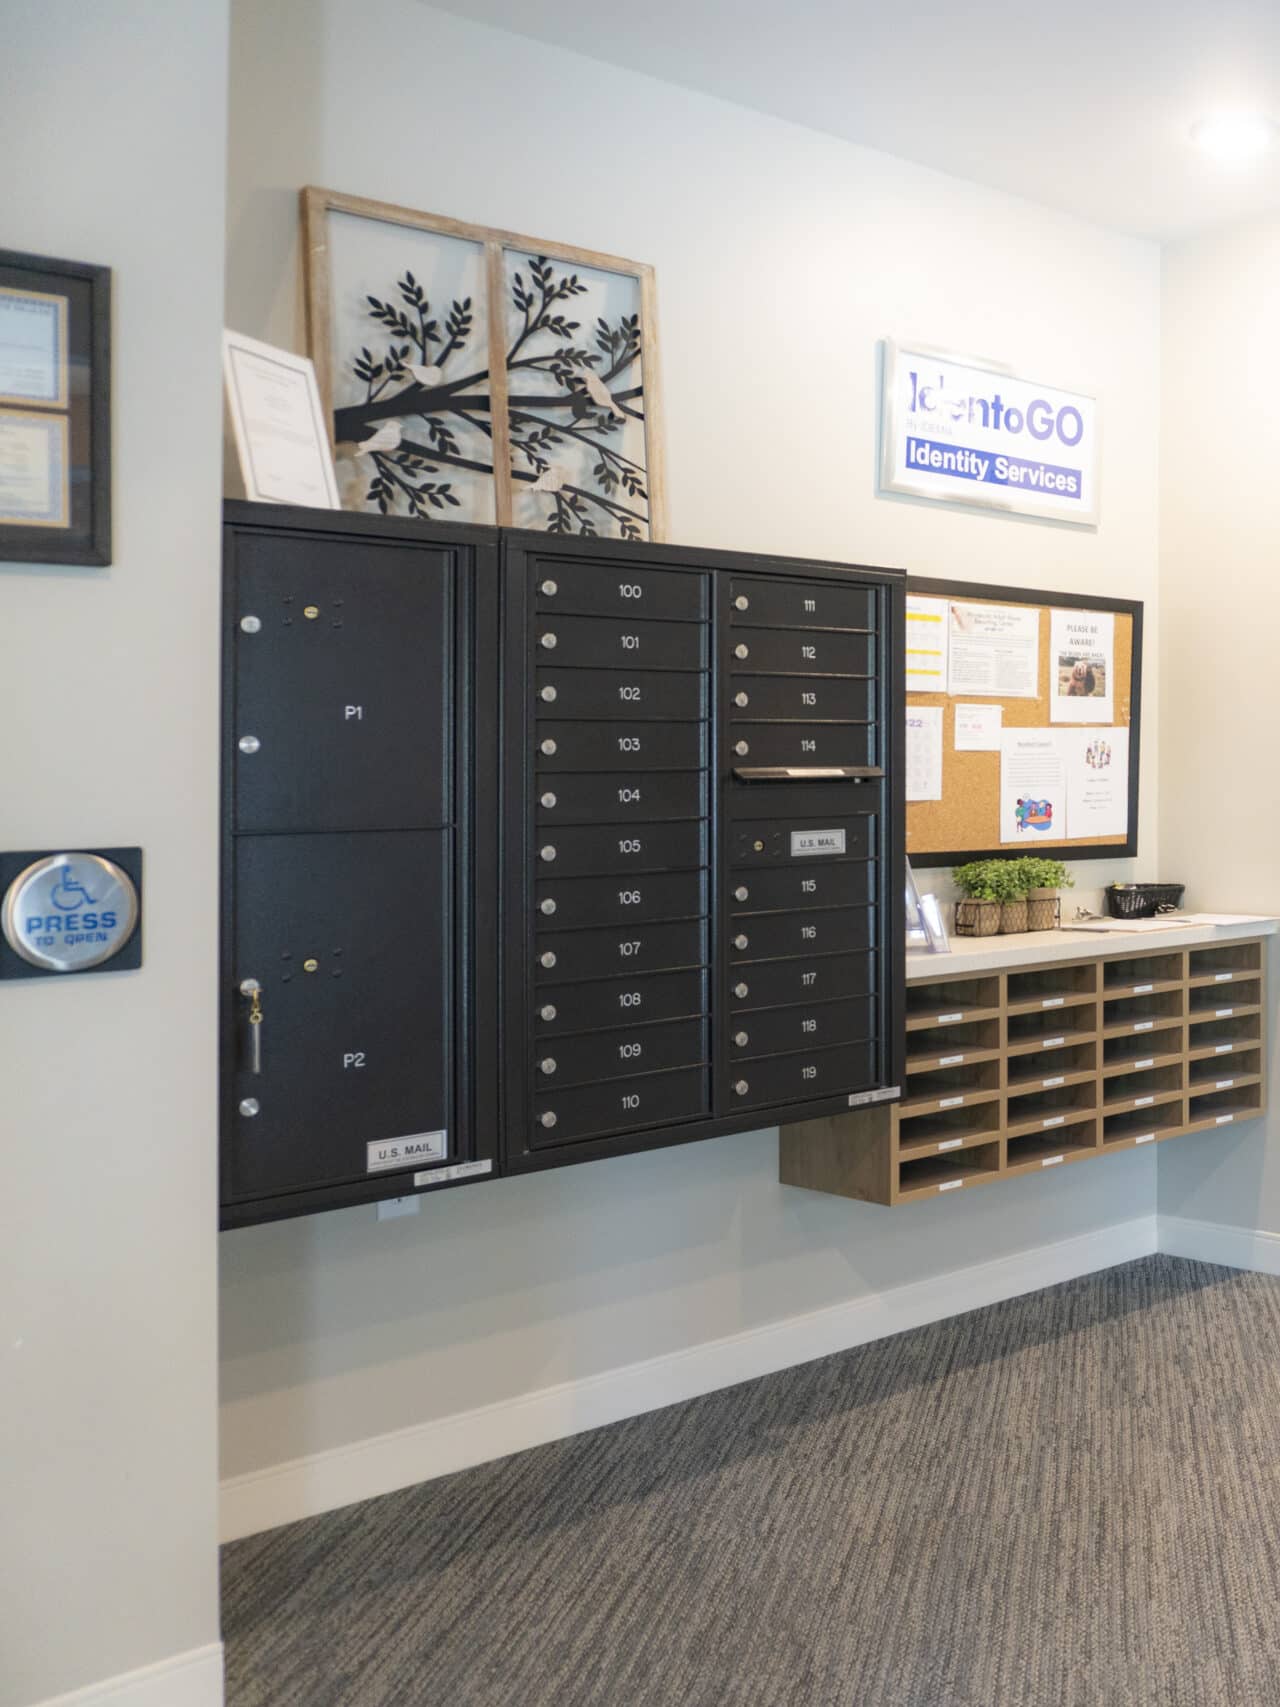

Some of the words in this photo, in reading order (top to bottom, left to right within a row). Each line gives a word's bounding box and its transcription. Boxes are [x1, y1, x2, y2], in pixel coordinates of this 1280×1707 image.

[909, 440, 990, 481] Identity
[994, 457, 1078, 493] Services
[619, 584, 642, 599] 100
[804, 599, 816, 612] 111
[621, 635, 640, 649] 101
[801, 646, 817, 659] 112
[618, 686, 641, 701] 102
[801, 692, 817, 705] 113
[344, 705, 362, 720] P1
[618, 737, 641, 752] 103
[801, 739, 817, 752] 114
[618, 788, 641, 803] 104
[618, 839, 641, 854] 105
[817, 837, 836, 847] MAIL
[801, 879, 817, 892] 115
[618, 890, 641, 905] 106
[26, 911, 117, 934] PRESS
[36, 935, 54, 946] TO
[64, 931, 107, 946] OPEN
[801, 925, 817, 939] 116
[619, 941, 641, 956] 107
[802, 972, 817, 985] 117
[619, 992, 642, 1007] 108
[801, 1019, 817, 1033] 118
[619, 1042, 642, 1059] 109
[343, 1052, 366, 1069] P2
[802, 1066, 817, 1079] 119
[621, 1094, 640, 1109] 110
[405, 1143, 433, 1154] MAIL
